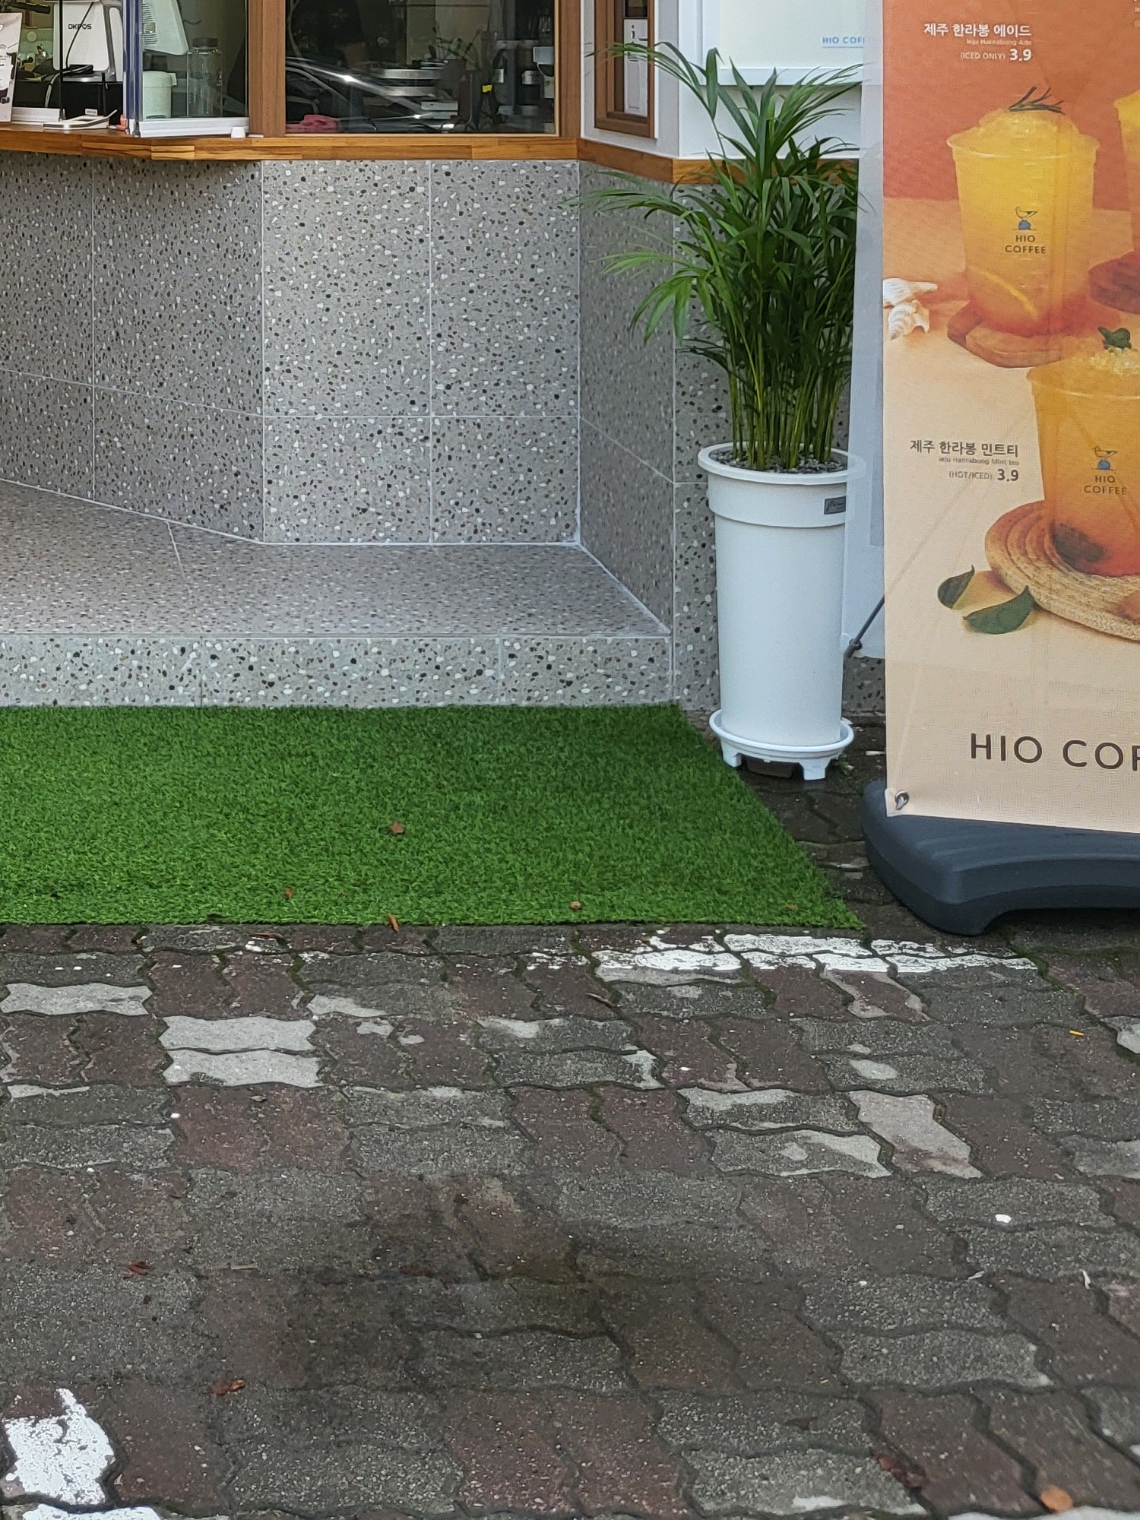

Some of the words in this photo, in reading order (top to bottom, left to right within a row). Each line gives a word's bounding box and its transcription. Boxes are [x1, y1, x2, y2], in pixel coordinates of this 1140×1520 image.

[924, 23, 948, 37] 제주
[952, 24, 989, 38] 한라봉
[994, 24, 1032, 38] 에이드
[822, 36, 839, 44] HIO
[1009, 48, 1032, 61] 3.9
[1015, 235, 1035, 243] HIO
[1004, 245, 1046, 254] COFFEE
[910, 440, 935, 454] 제주
[939, 441, 976, 456] 한라봉
[981, 443, 1018, 458] 민트티
[997, 469, 1019, 482] 3.9
[1094, 475, 1116, 484] HIO
[969, 731, 1043, 764] HIO
